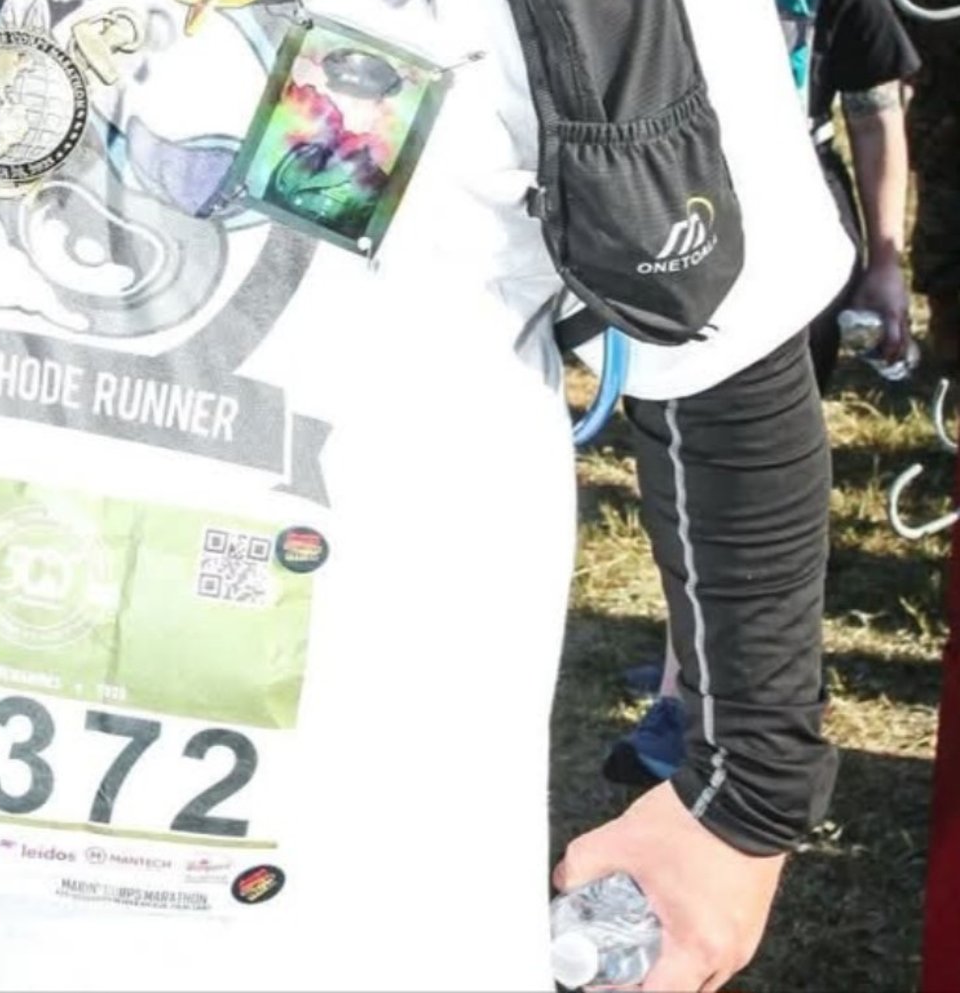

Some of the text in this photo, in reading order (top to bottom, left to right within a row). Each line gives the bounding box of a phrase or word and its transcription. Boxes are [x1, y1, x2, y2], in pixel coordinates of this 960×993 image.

[47, 45, 87, 110] MARATHON
[92, 372, 240, 442] RUNNER
[21, 844, 77, 863] leidos
